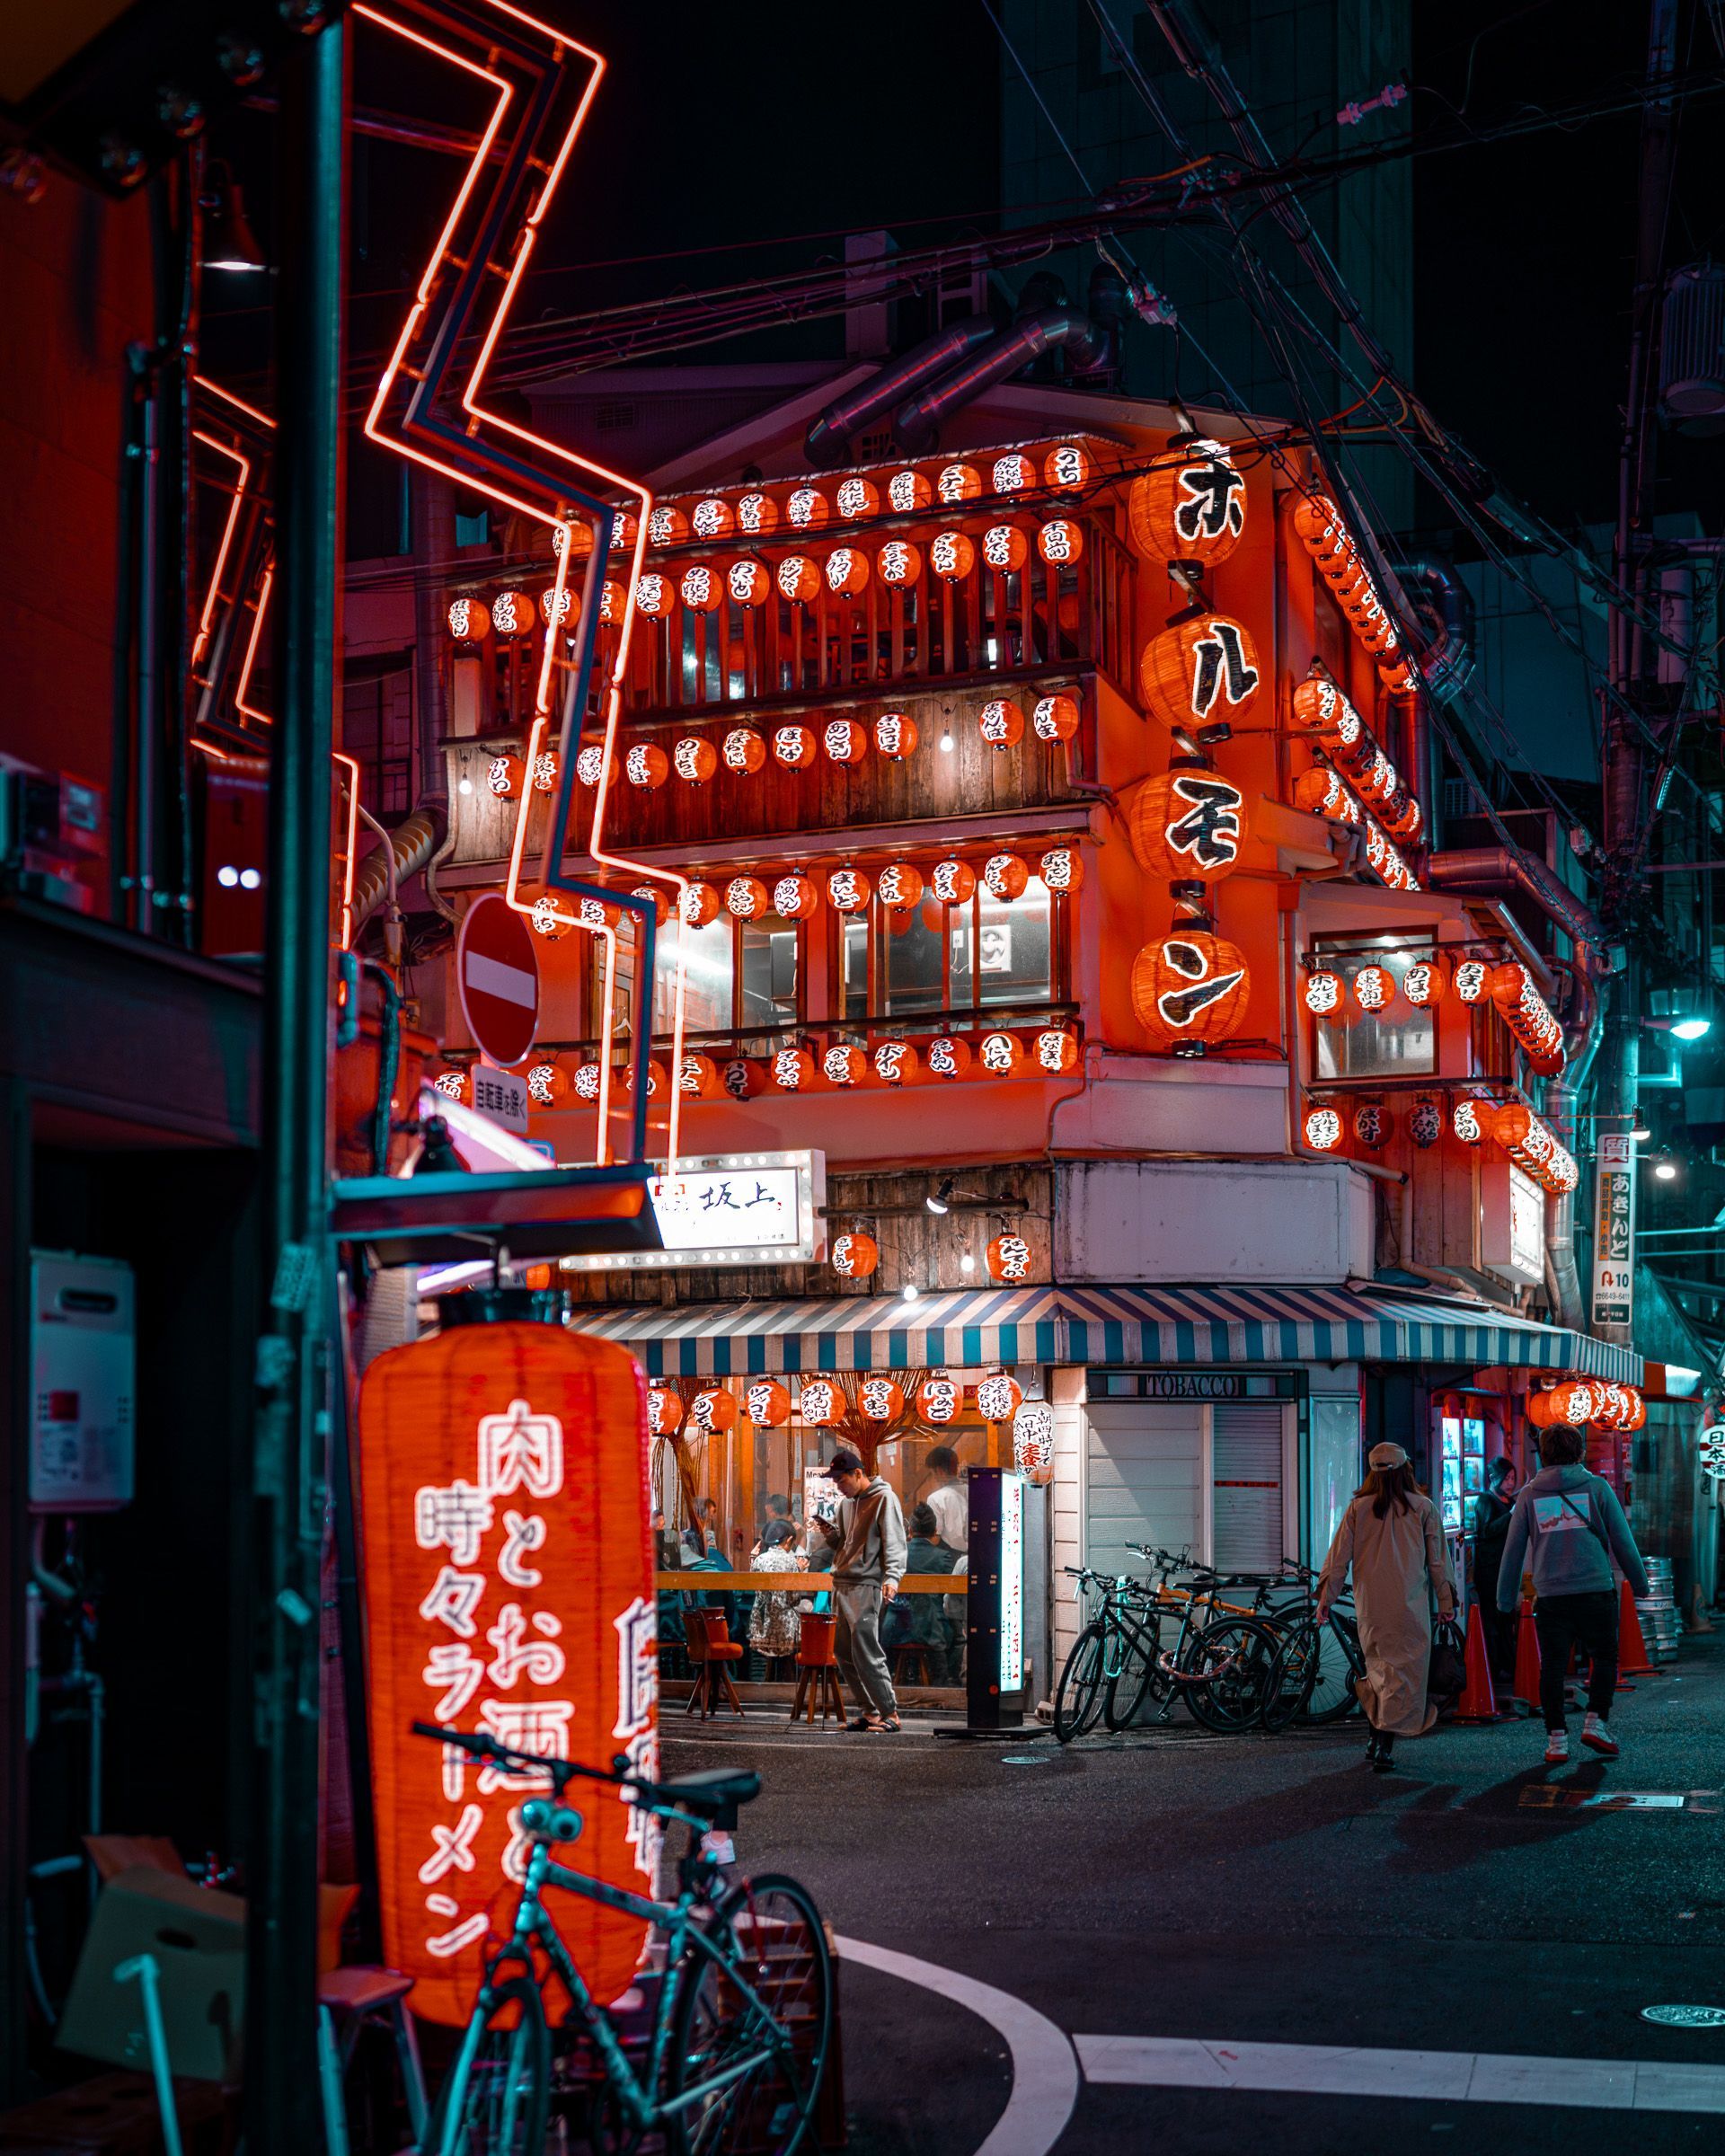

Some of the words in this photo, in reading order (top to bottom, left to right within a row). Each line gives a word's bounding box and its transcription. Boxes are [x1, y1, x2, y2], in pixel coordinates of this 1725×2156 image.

[1056, 448, 1081, 484] うち
[1043, 522, 1070, 559] 千日前
[776, 729, 802, 761] ほな
[488, 757, 509, 793] かしわ
[831, 872, 859, 907] まいど
[933, 862, 958, 900] おもろい
[1406, 967, 1429, 1002] あほか
[876, 1045, 906, 1079] ボイン
[982, 1035, 1012, 1069] へたれ
[1358, 1107, 1380, 1142] ほかす
[1604, 1137, 1629, 1162] 質
[699, 1181, 775, 1211] 坂上
[1610, 1173, 1630, 1259] あきんど
[999, 1239, 1028, 1277] なんでっか
[1615, 1273, 1630, 1287] 10
[863, 1381, 892, 1418] 焼きまっせ
[924, 1383, 954, 1419] はみご
[1146, 1375, 1236, 1396] TOBACCO
[748, 1385, 772, 1425] ツッコミ
[1021, 1414, 1041, 1474] 一日中定食が
[1036, 1409, 1054, 1465] 朝四時まで
[1707, 1430, 1725, 1475] 日本酒
[414, 1479, 493, 1957] 時々ラーメン
